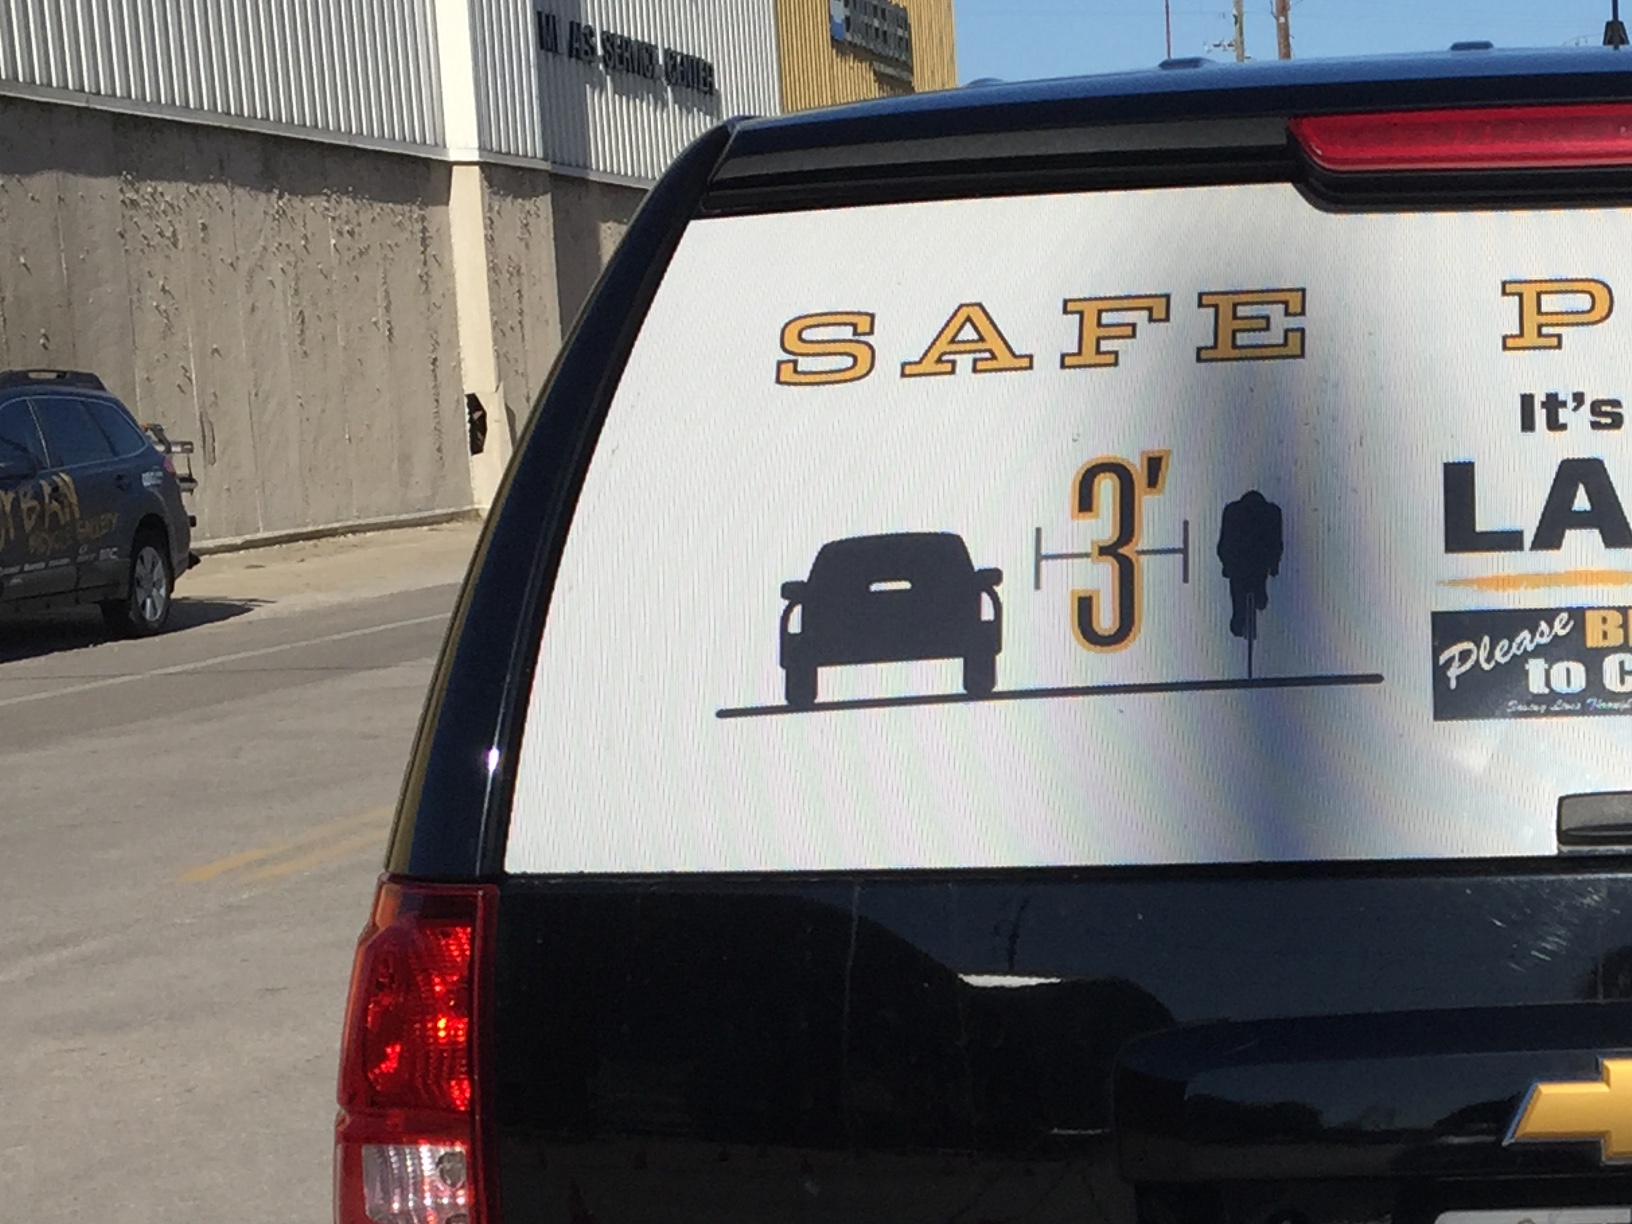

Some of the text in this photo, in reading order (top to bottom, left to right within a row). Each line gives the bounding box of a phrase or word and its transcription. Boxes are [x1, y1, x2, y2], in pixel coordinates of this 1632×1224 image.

[775, 287, 1306, 386] SAFE
[1519, 391, 1625, 433] It's
[1070, 448, 1171, 655] 3'
[1439, 611, 1575, 690] Please
[1525, 658, 1588, 694] to
